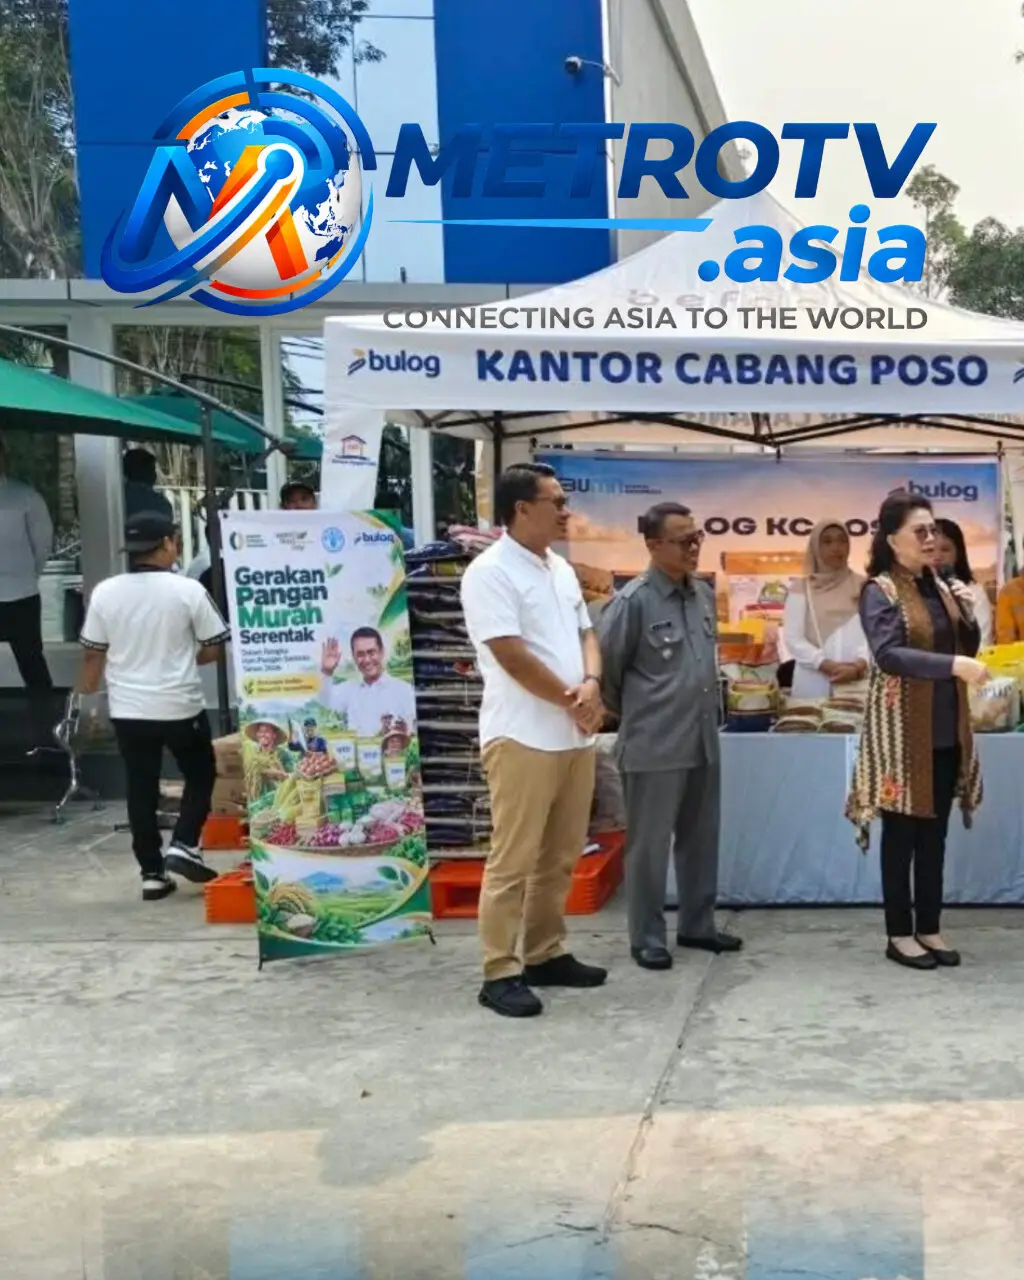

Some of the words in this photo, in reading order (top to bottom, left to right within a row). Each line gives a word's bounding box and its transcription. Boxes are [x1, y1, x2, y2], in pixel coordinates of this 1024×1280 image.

[367, 348, 441, 377] bulog
[476, 350, 669, 384] KANTOR
[675, 352, 857, 386] CABANG
[870, 354, 988, 386] POSO
[909, 481, 978, 501] bulog
[235, 564, 325, 586] Gerakan
[236, 585, 328, 608] Pangan
[238, 603, 323, 628] Murah
[240, 627, 315, 644] Serentak
